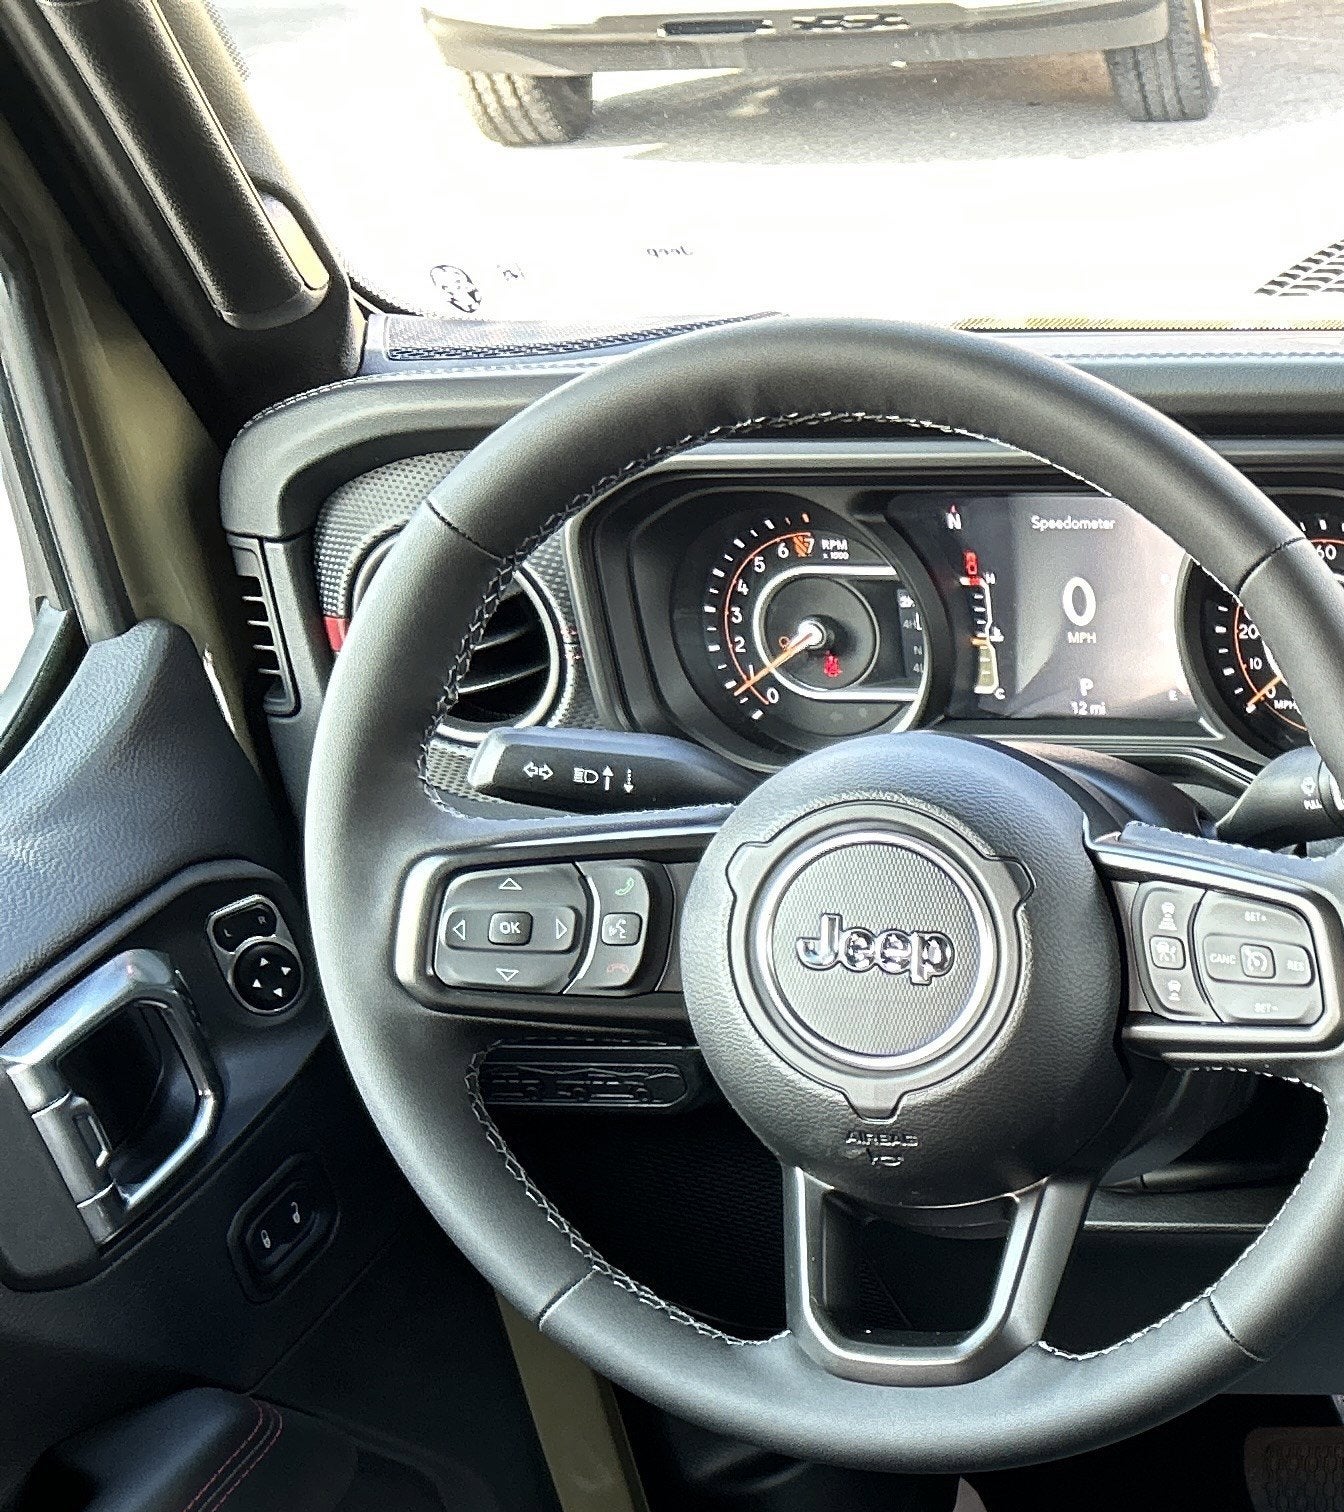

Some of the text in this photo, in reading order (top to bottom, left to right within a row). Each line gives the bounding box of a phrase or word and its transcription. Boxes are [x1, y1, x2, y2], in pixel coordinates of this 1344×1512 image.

[1030, 515, 1115, 532] Speedometer
[777, 541, 790, 559] 6
[821, 538, 849, 552] RPM
[753, 555, 766, 573] 5
[737, 578, 751, 596] 4
[1061, 576, 1097, 627] 0
[730, 606, 743, 624] 3
[1066, 631, 1097, 644] MPH
[1238, 624, 1259, 640] 20
[734, 635, 747, 654] 2
[1249, 657, 1263, 671] 10
[765, 686, 781, 705] 0
[499, 920, 522, 935] OK
[795, 911, 956, 987] Jeep
[1209, 952, 1237, 966] CANC
